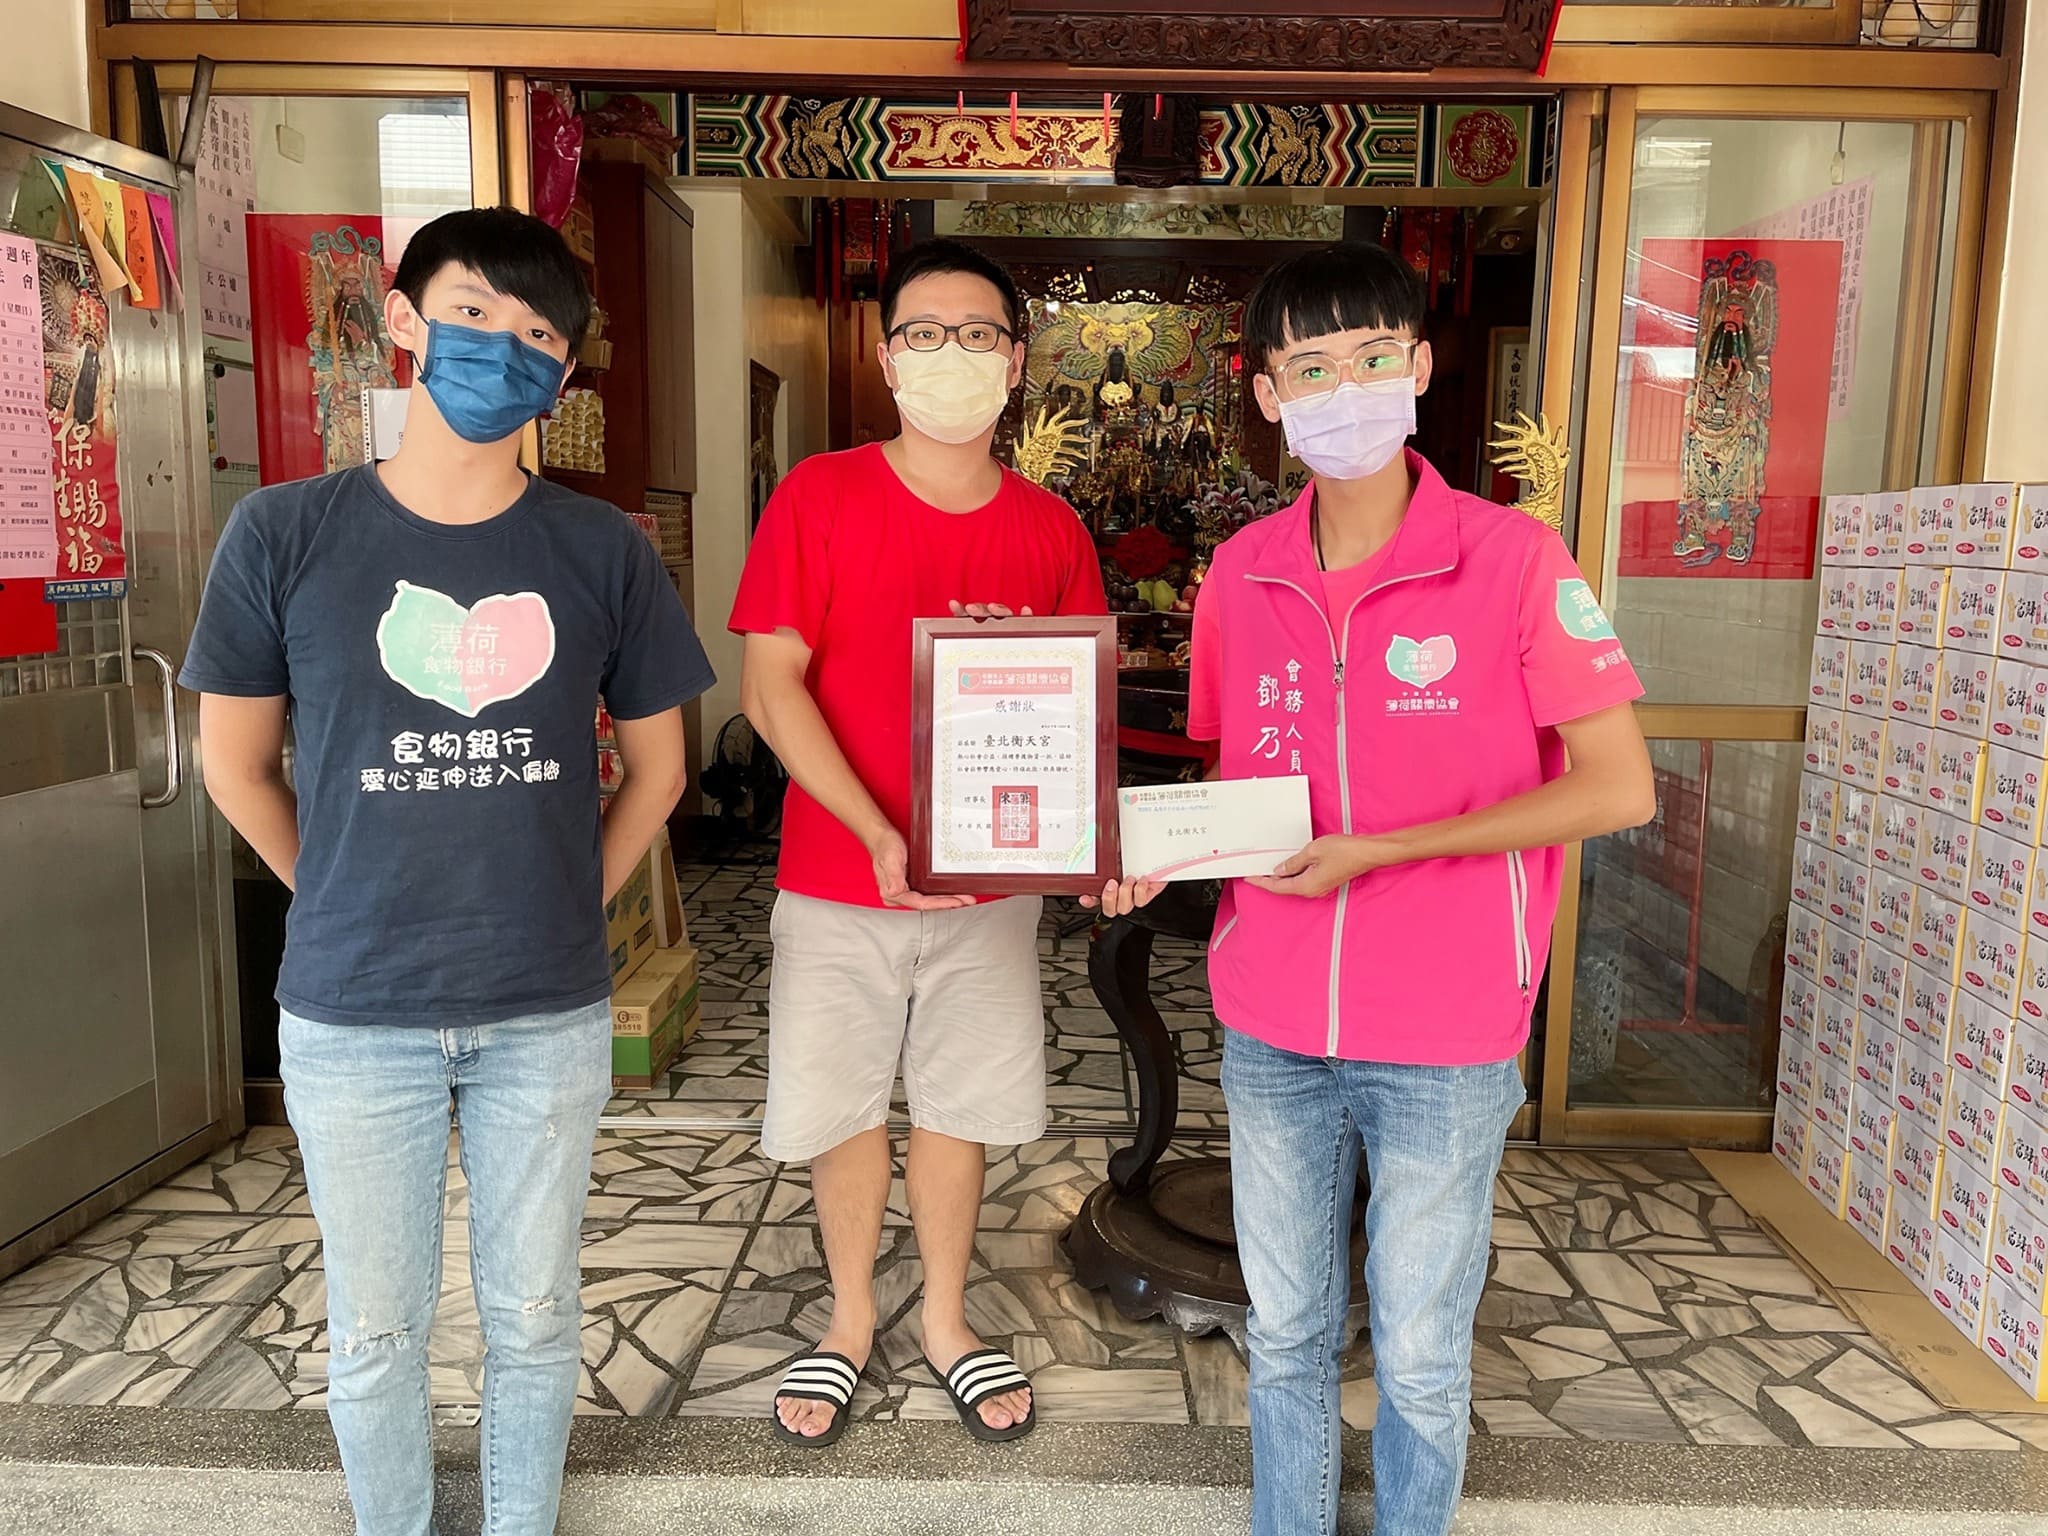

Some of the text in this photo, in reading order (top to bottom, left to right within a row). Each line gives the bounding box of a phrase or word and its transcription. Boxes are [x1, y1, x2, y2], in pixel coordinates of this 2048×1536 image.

[0, 246, 32, 266] 週年
[430, 623, 500, 655] 薄荷
[423, 656, 508, 676] 食物銀行
[995, 700, 1036, 713] 感謝狀
[1285, 658, 1305, 774] 會務人員
[1250, 673, 1280, 779] 鄧乃
[391, 727, 533, 764] 食物銀行
[360, 758, 561, 792] 愛心延伸送入偏鄉
